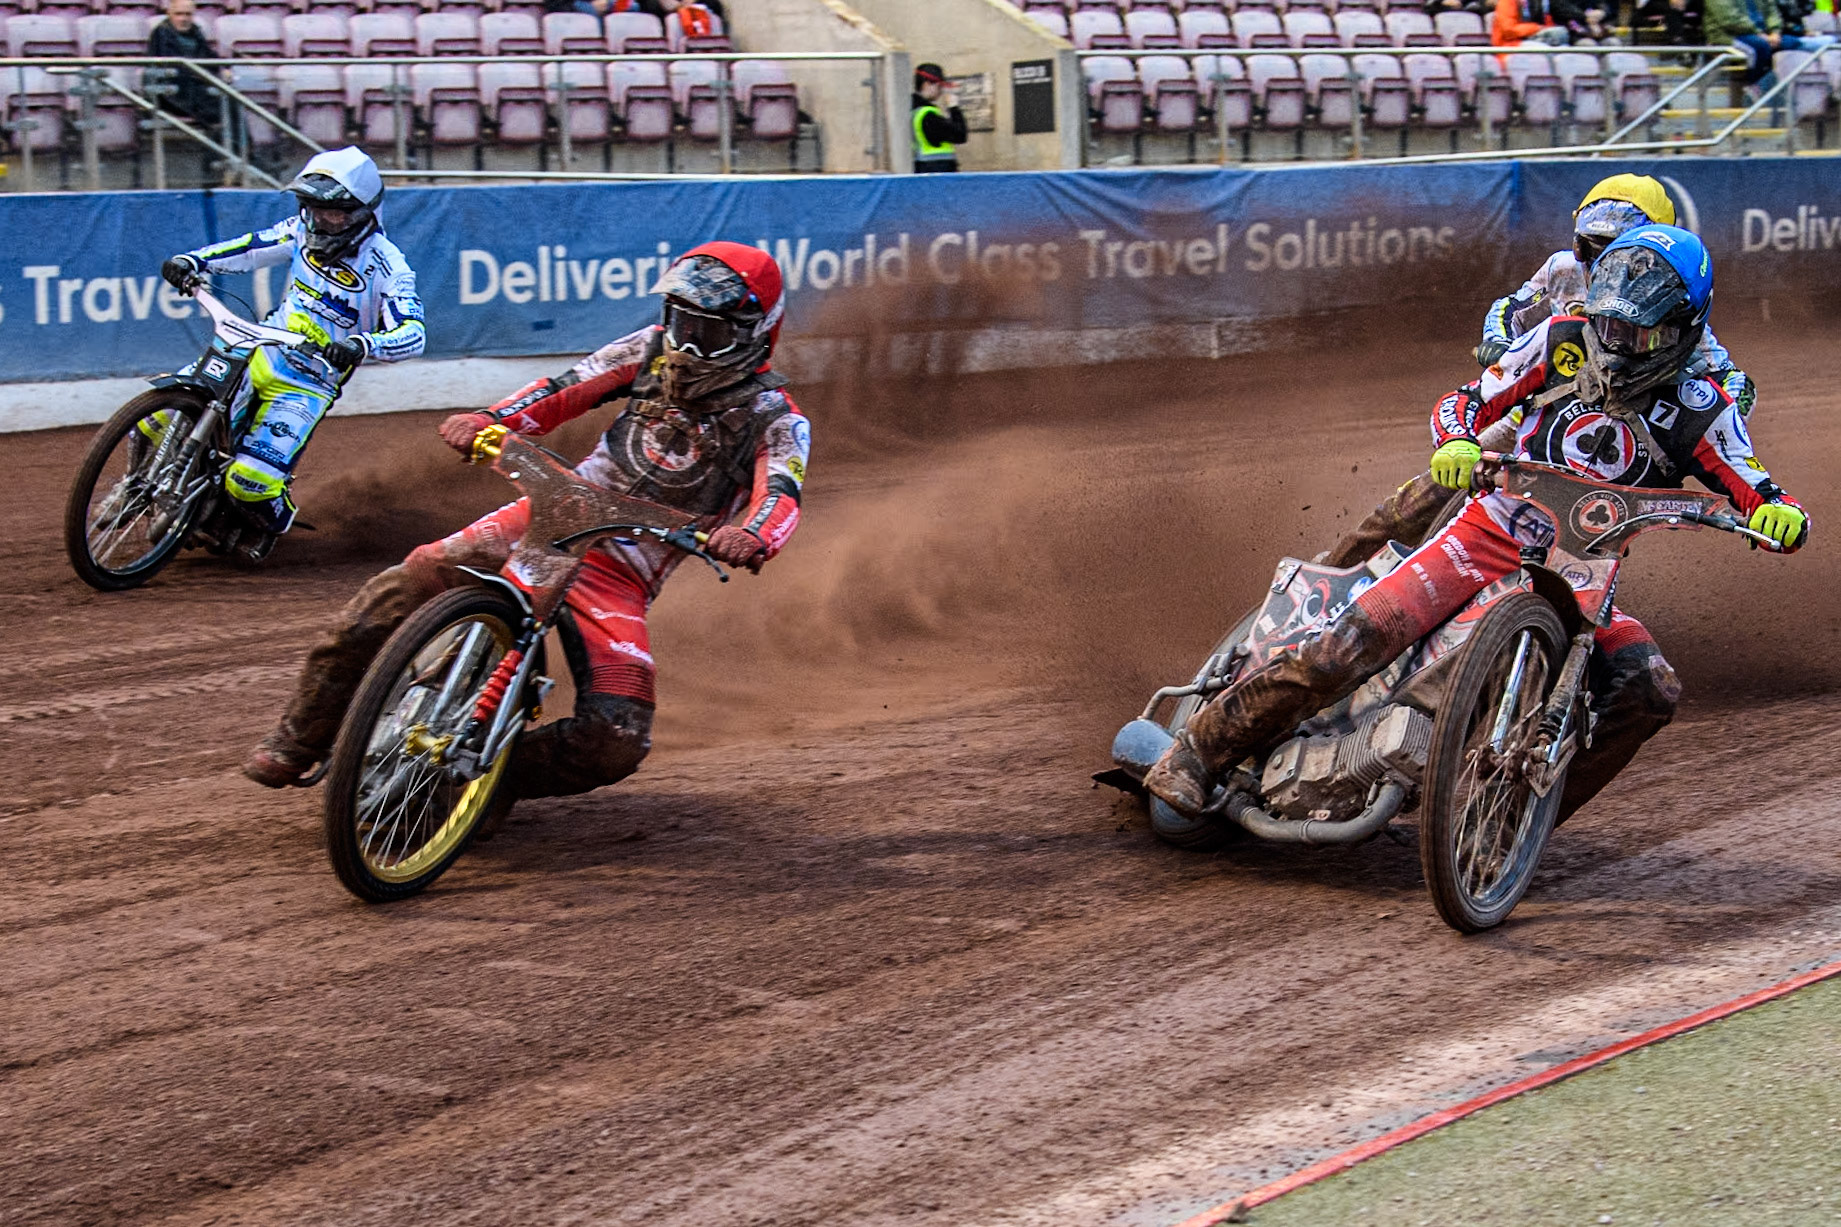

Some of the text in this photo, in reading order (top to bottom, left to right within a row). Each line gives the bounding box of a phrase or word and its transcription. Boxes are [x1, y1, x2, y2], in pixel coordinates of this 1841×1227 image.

[1743, 205, 1841, 251] Deliv
[459, 217, 1455, 305] Deliveri World Class Travel Solutions
[23, 265, 212, 325] Trave
[1602, 299, 1634, 315] SHOEI
[1653, 402, 1676, 423] 7
